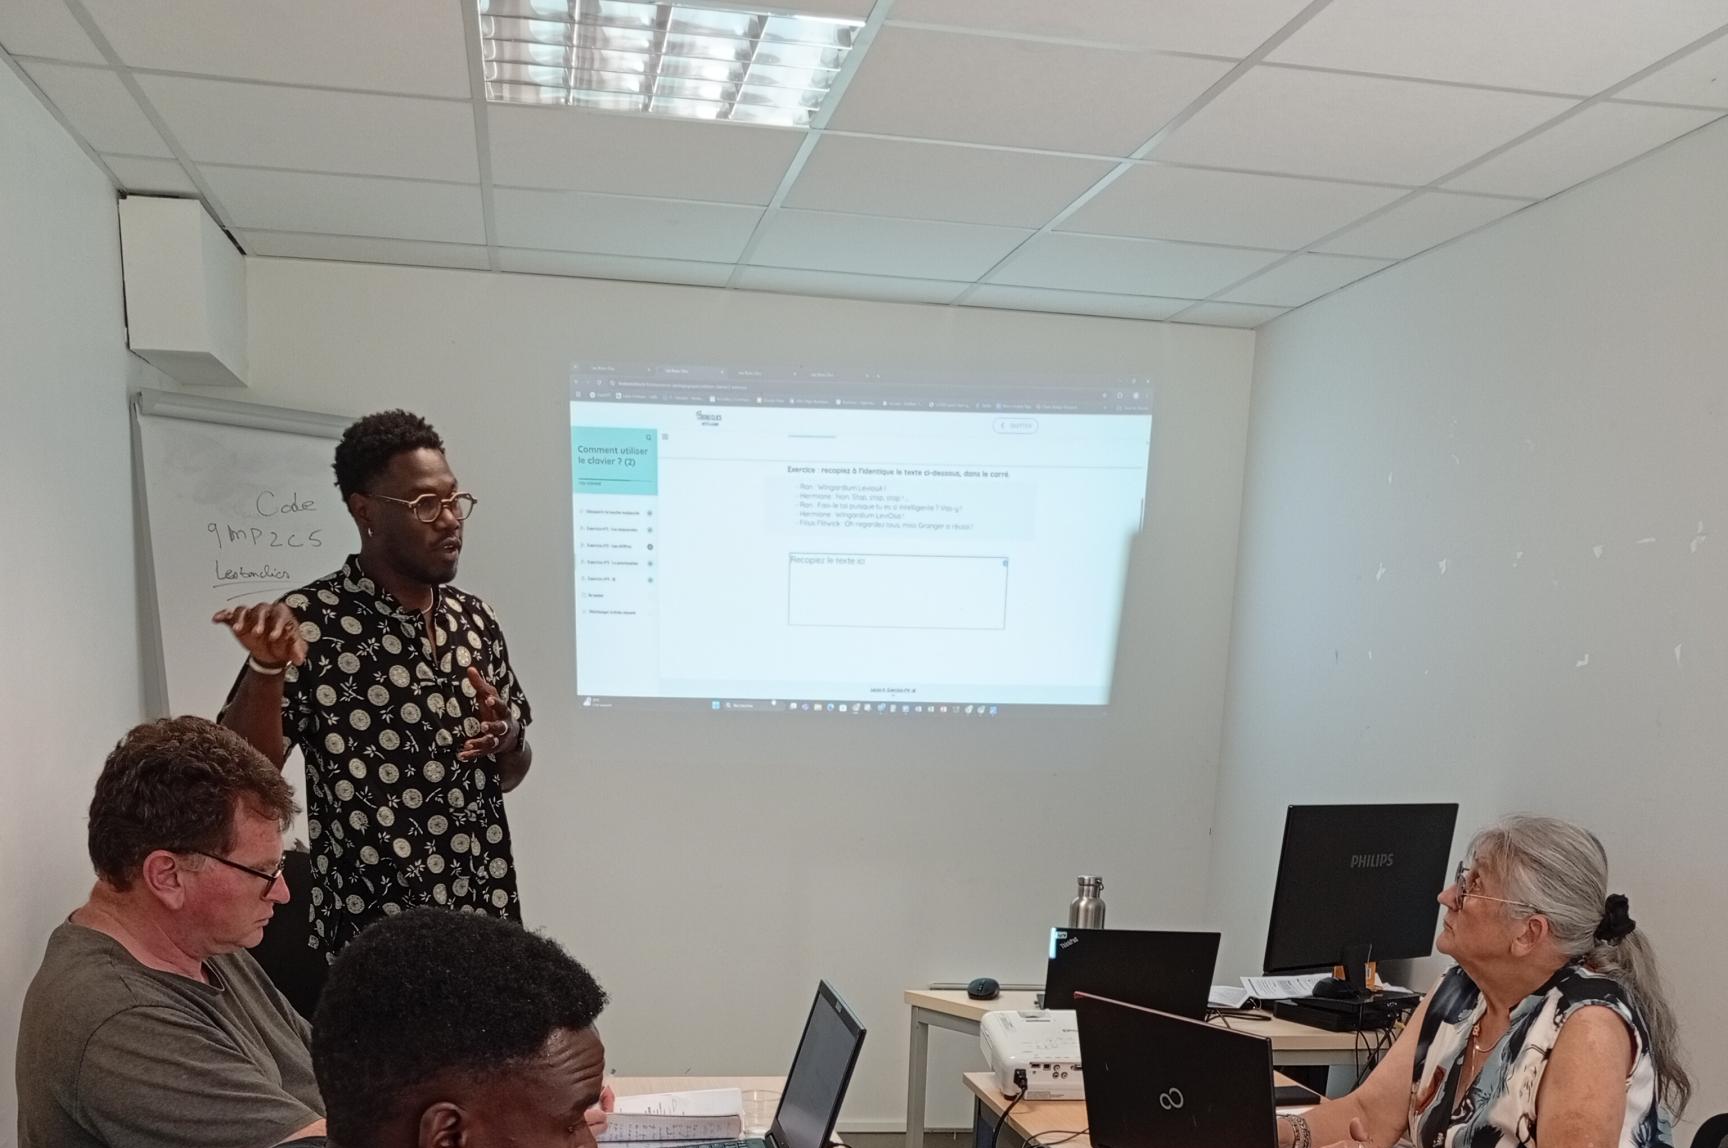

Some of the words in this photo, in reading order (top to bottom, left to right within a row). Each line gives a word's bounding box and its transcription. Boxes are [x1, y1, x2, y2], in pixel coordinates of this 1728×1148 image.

[577, 445, 618, 455] Comment
[620, 446, 649, 456] utiliser
[577, 456, 586, 464] le
[587, 456, 616, 466] clavier
[624, 457, 636, 468] (2)
[787, 465, 816, 474] Exercice
[904, 468, 922, 477] texte
[256, 490, 317, 517] Code
[1350, 853, 1394, 869] PHILIPS
